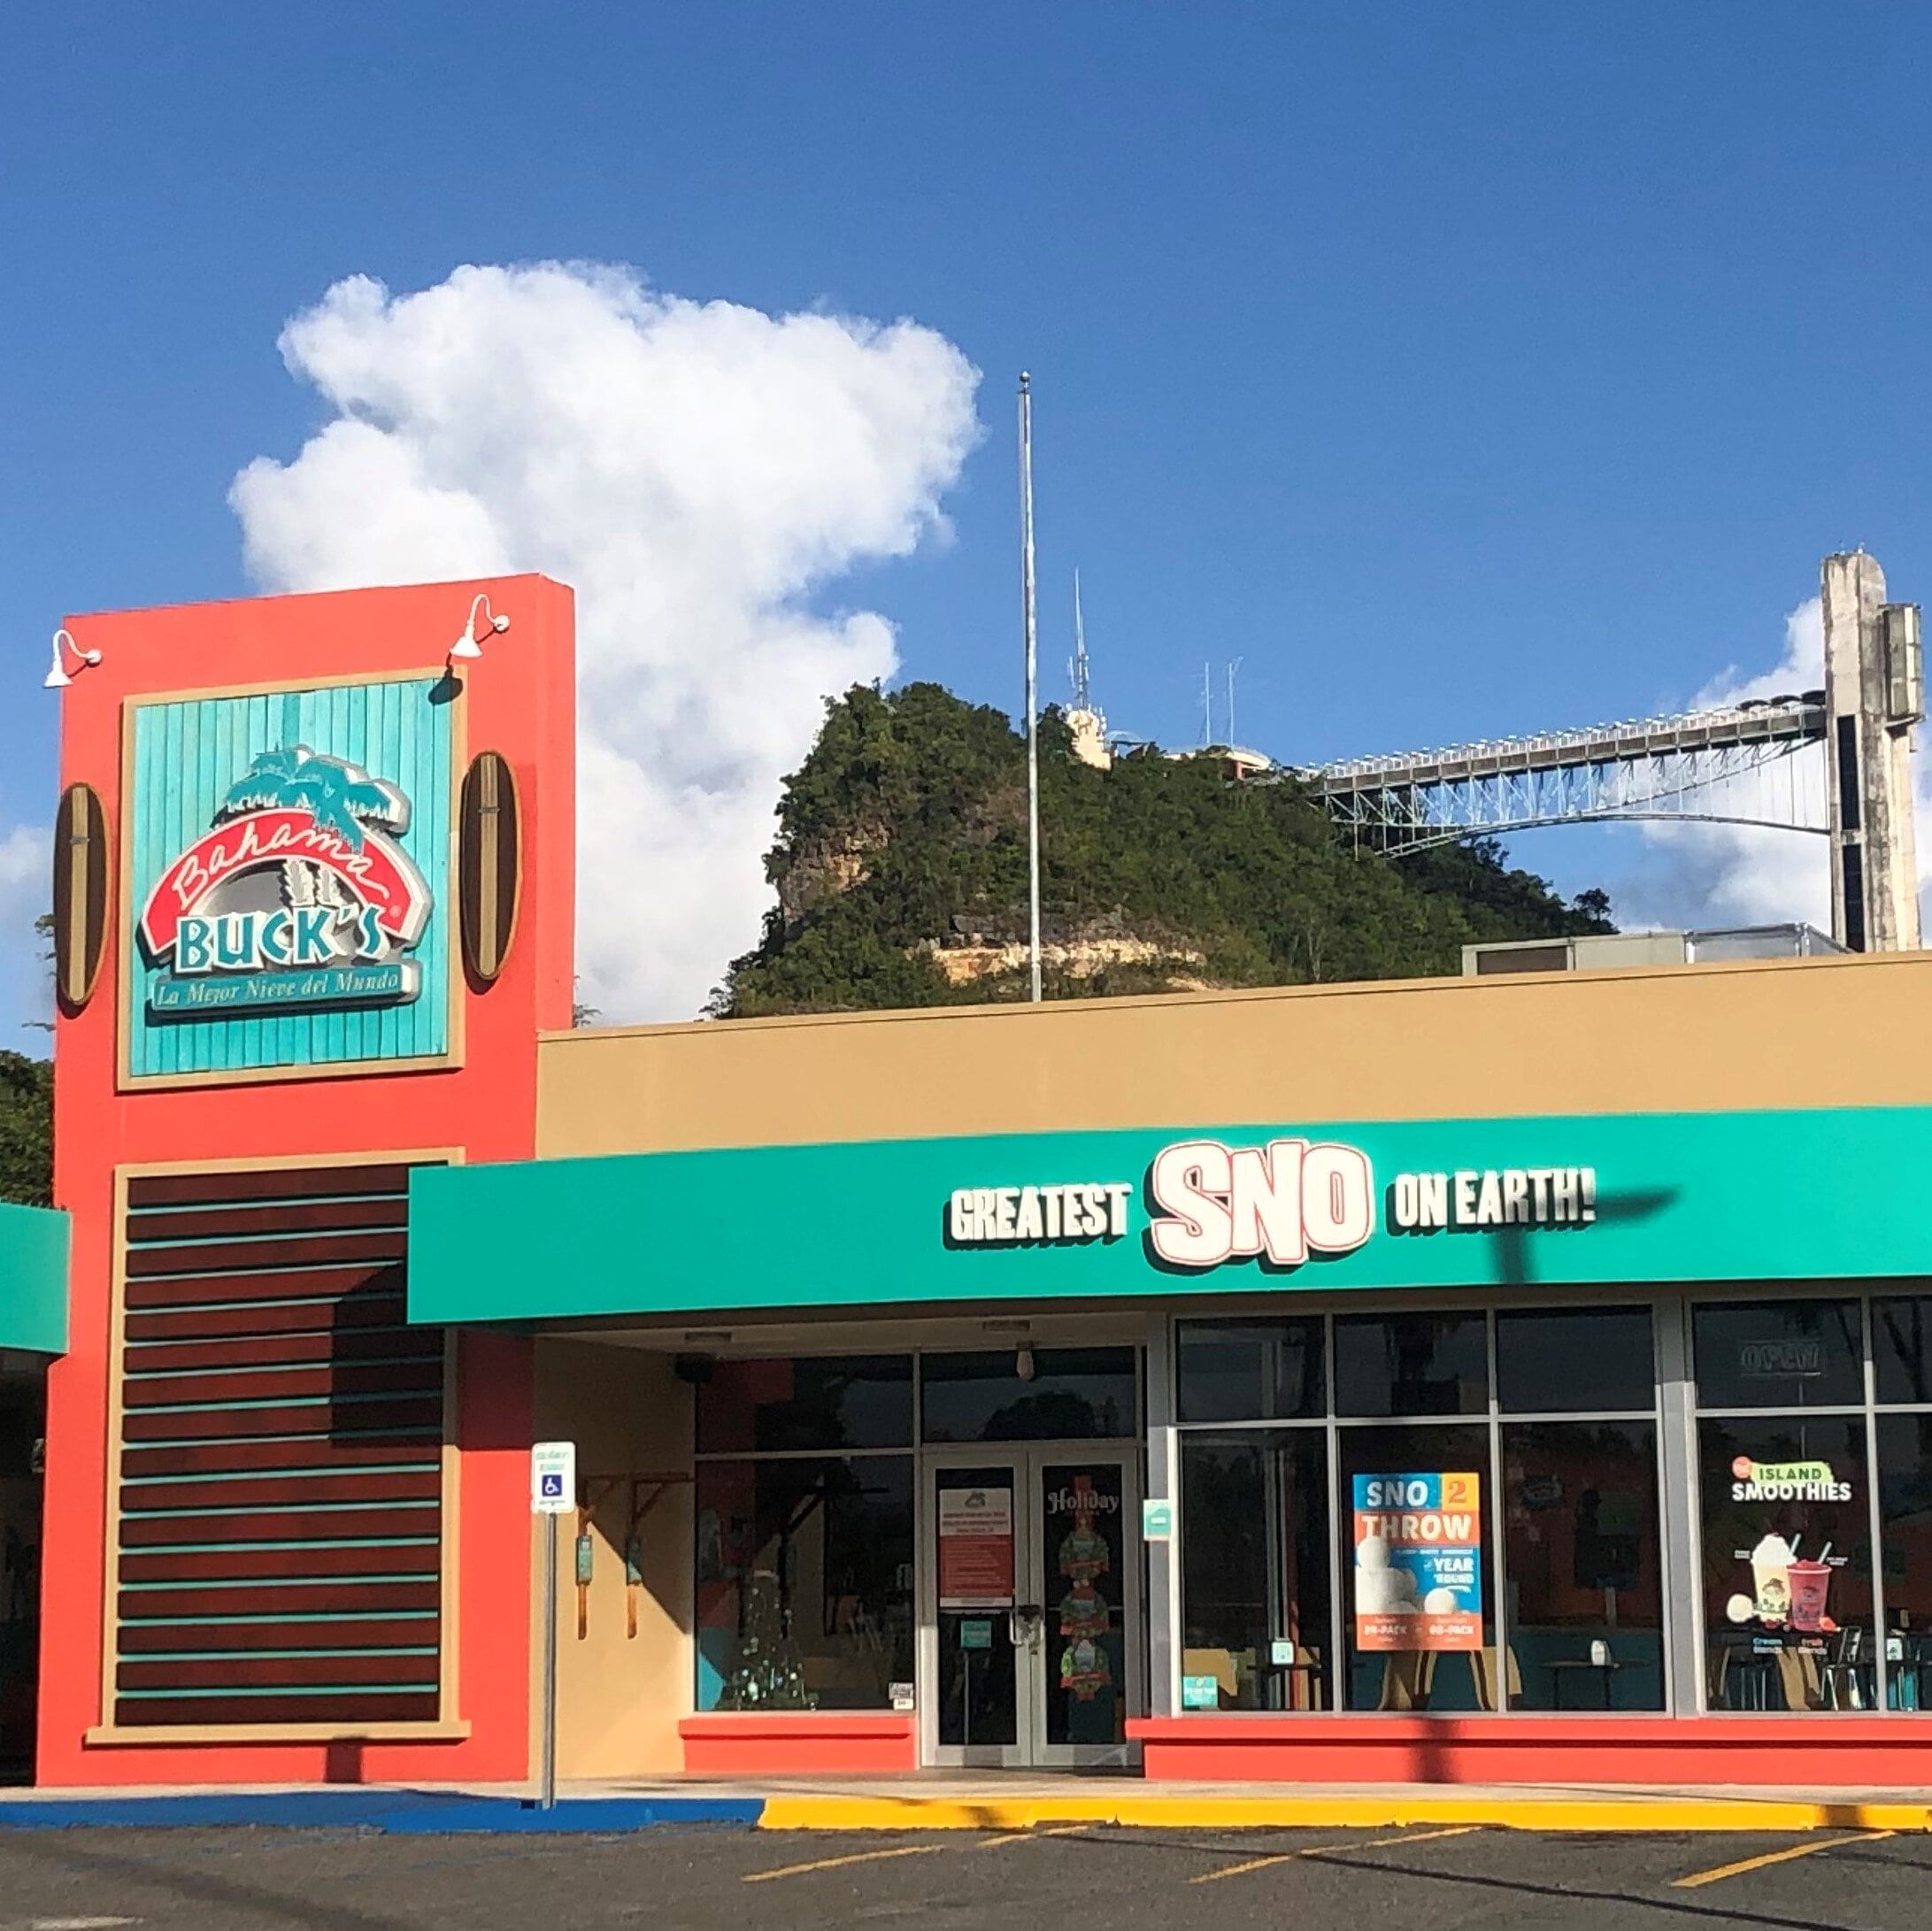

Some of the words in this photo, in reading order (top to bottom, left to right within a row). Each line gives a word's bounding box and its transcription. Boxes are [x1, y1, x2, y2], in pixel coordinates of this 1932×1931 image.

[172, 823, 391, 911] Bahama
[177, 904, 384, 973] BUCK'S
[157, 985, 177, 1005] La
[245, 979, 296, 998] Nieve
[301, 976, 327, 995] del
[335, 972, 397, 992] Mundo
[950, 1181, 1133, 1241] GREATEST
[1150, 1138, 1375, 1266] SNO
[1394, 1172, 1446, 1227] ON
[1456, 1167, 1597, 1225] EARTH!
[1759, 1467, 1823, 1481] ISLAND
[1366, 1480, 1429, 1507] SNO
[1447, 1480, 1467, 1504] 2
[1731, 1481, 1852, 1502] SMOOTHIES
[1360, 1514, 1472, 1542] THROW
[1433, 1558, 1474, 1573] YEAR
